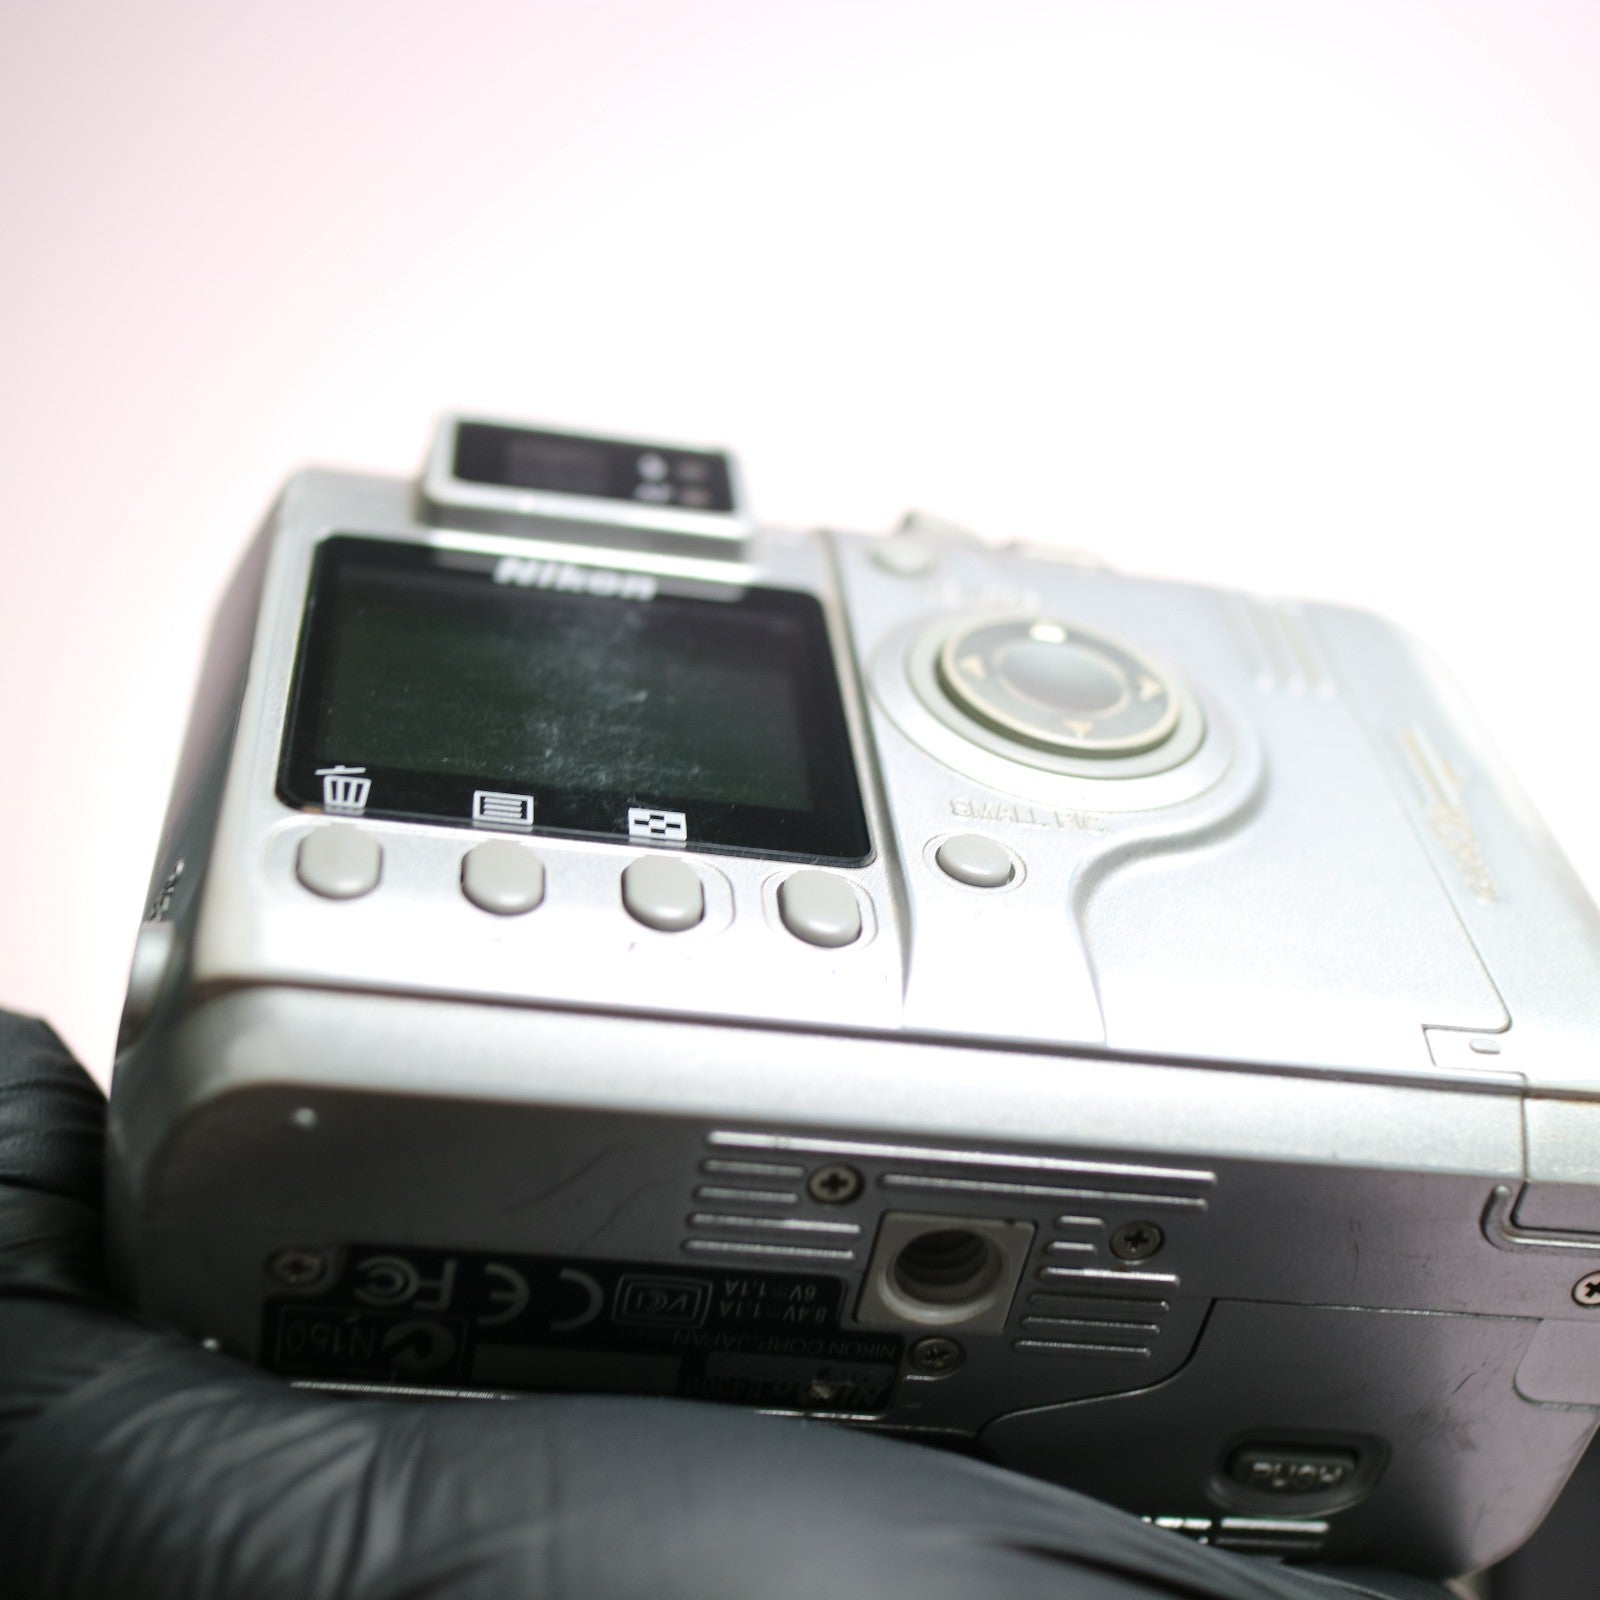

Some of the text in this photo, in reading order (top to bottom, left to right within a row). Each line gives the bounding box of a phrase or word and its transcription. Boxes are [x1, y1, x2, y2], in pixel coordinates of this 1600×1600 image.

[492, 556, 657, 601] Nikon
[949, 798, 1050, 827] SMALL
[827, 1340, 897, 1359] NIKON
[1250, 1460, 1344, 1490] PUSH
